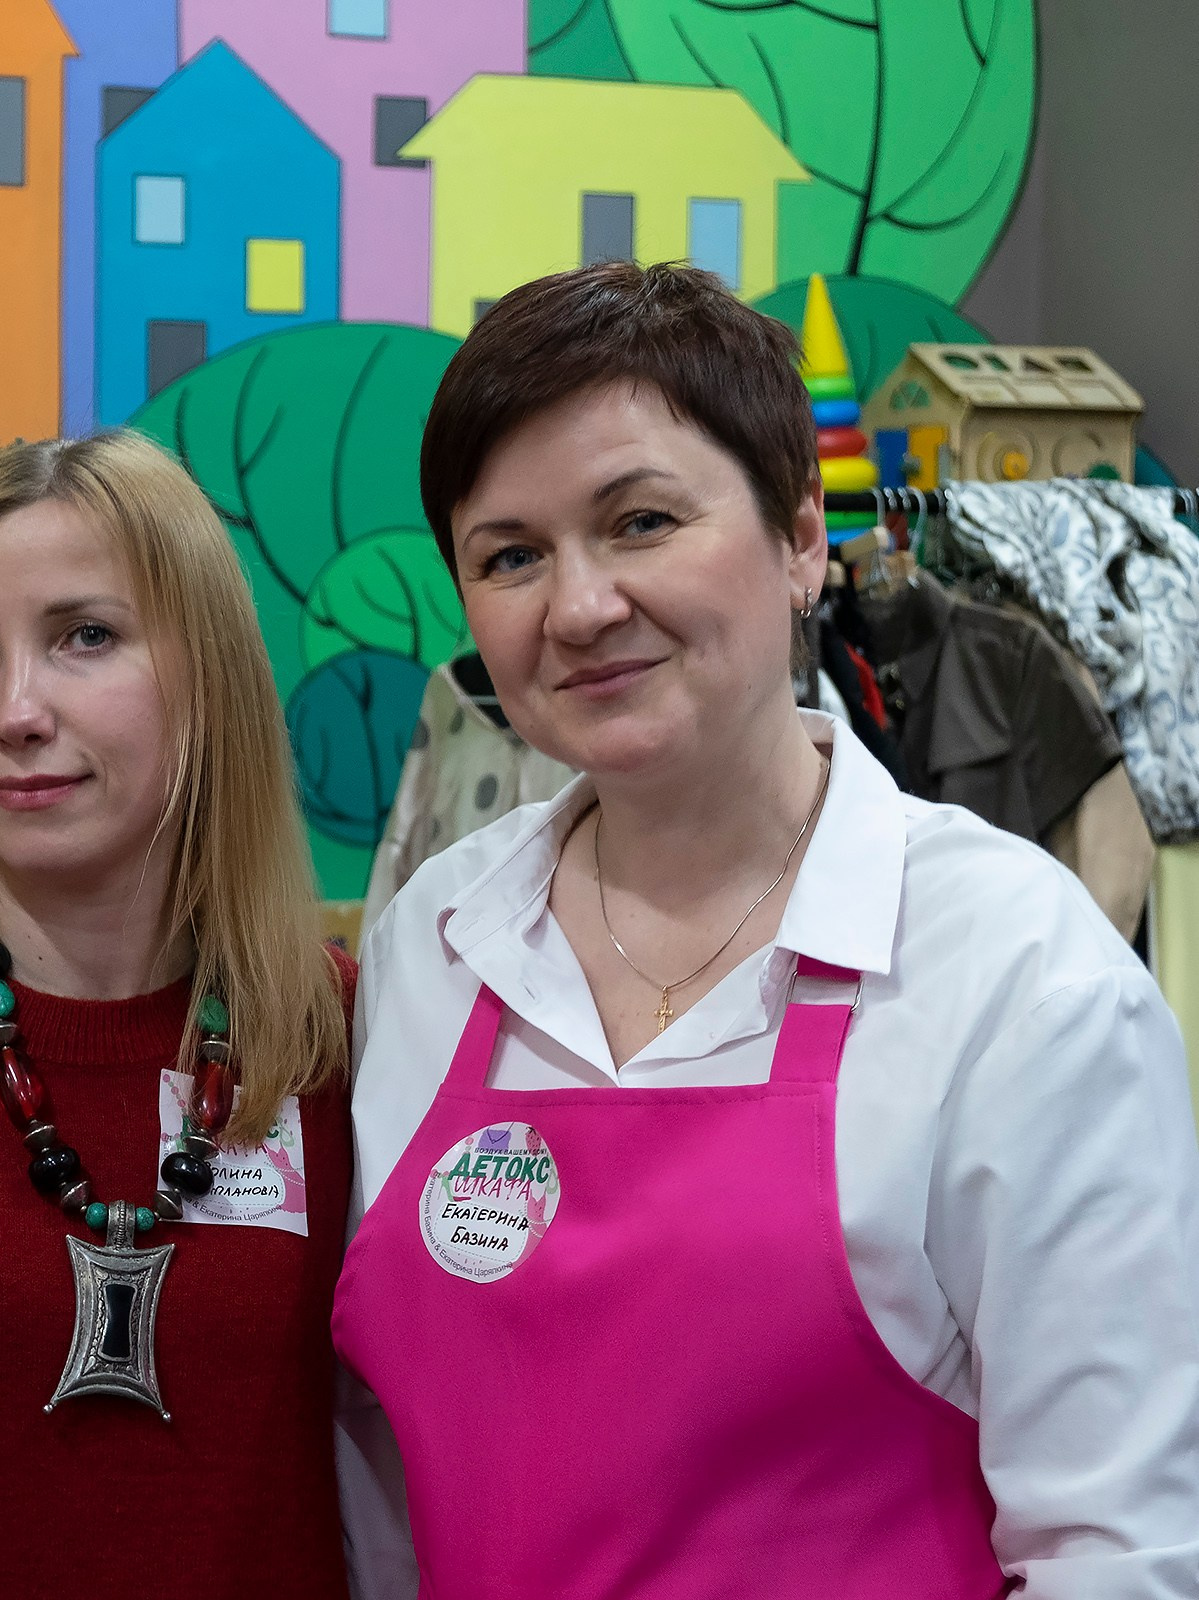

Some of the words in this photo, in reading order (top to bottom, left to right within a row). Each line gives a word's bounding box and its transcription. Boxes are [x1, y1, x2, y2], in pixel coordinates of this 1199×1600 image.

[212, 1166, 263, 1181] ОЛИНА
[448, 1152, 550, 1184] ДЕТОКС
[454, 1175, 531, 1201] ШКАФА
[200, 1204, 242, 1221] Екатерина
[442, 1203, 529, 1232] ЕКАТЕРИНА
[451, 1226, 509, 1251] БАЗИНА
[440, 1249, 473, 1275] Екатерина
